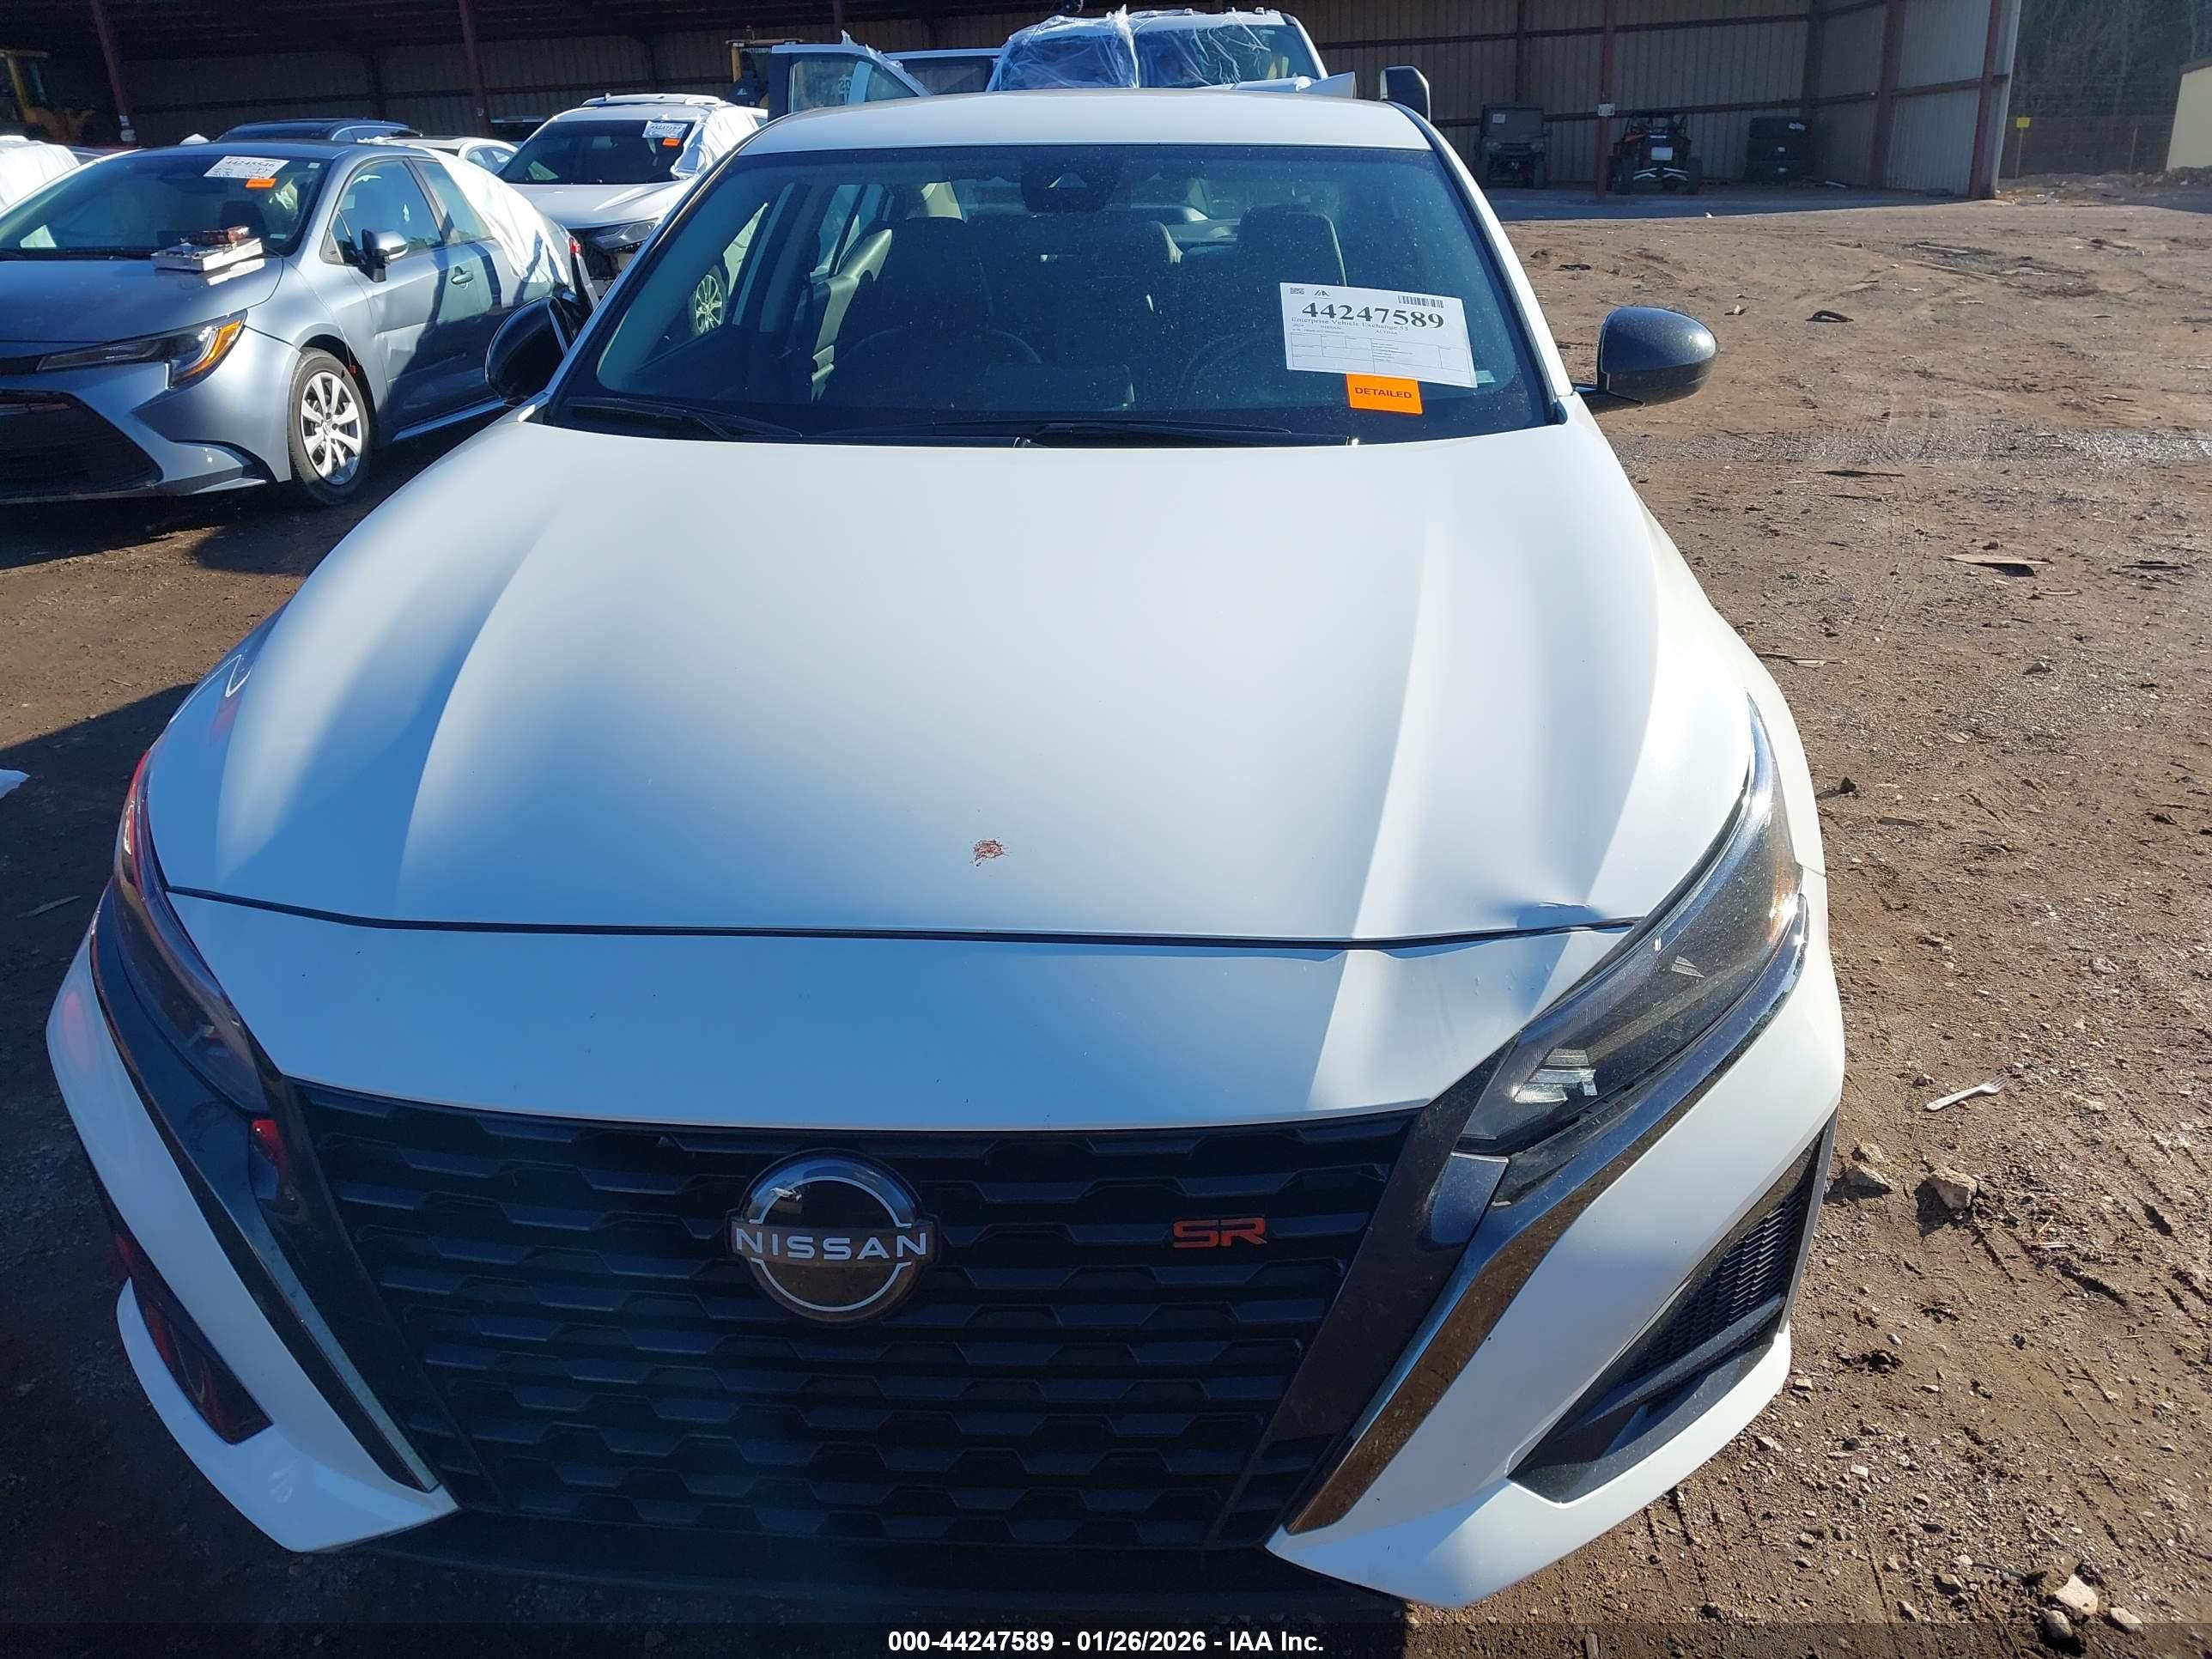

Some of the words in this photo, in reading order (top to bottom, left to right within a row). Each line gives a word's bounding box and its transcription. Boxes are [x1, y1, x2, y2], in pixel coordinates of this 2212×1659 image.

[1291, 316, 1329, 325] Enterprise
[1361, 322, 1398, 331] Exchange
[1302, 301, 1444, 328] 44247589
[1355, 386, 1413, 399] DETAILED
[734, 1228, 927, 1261] NISSAN
[1173, 1216, 1268, 1249] SR
